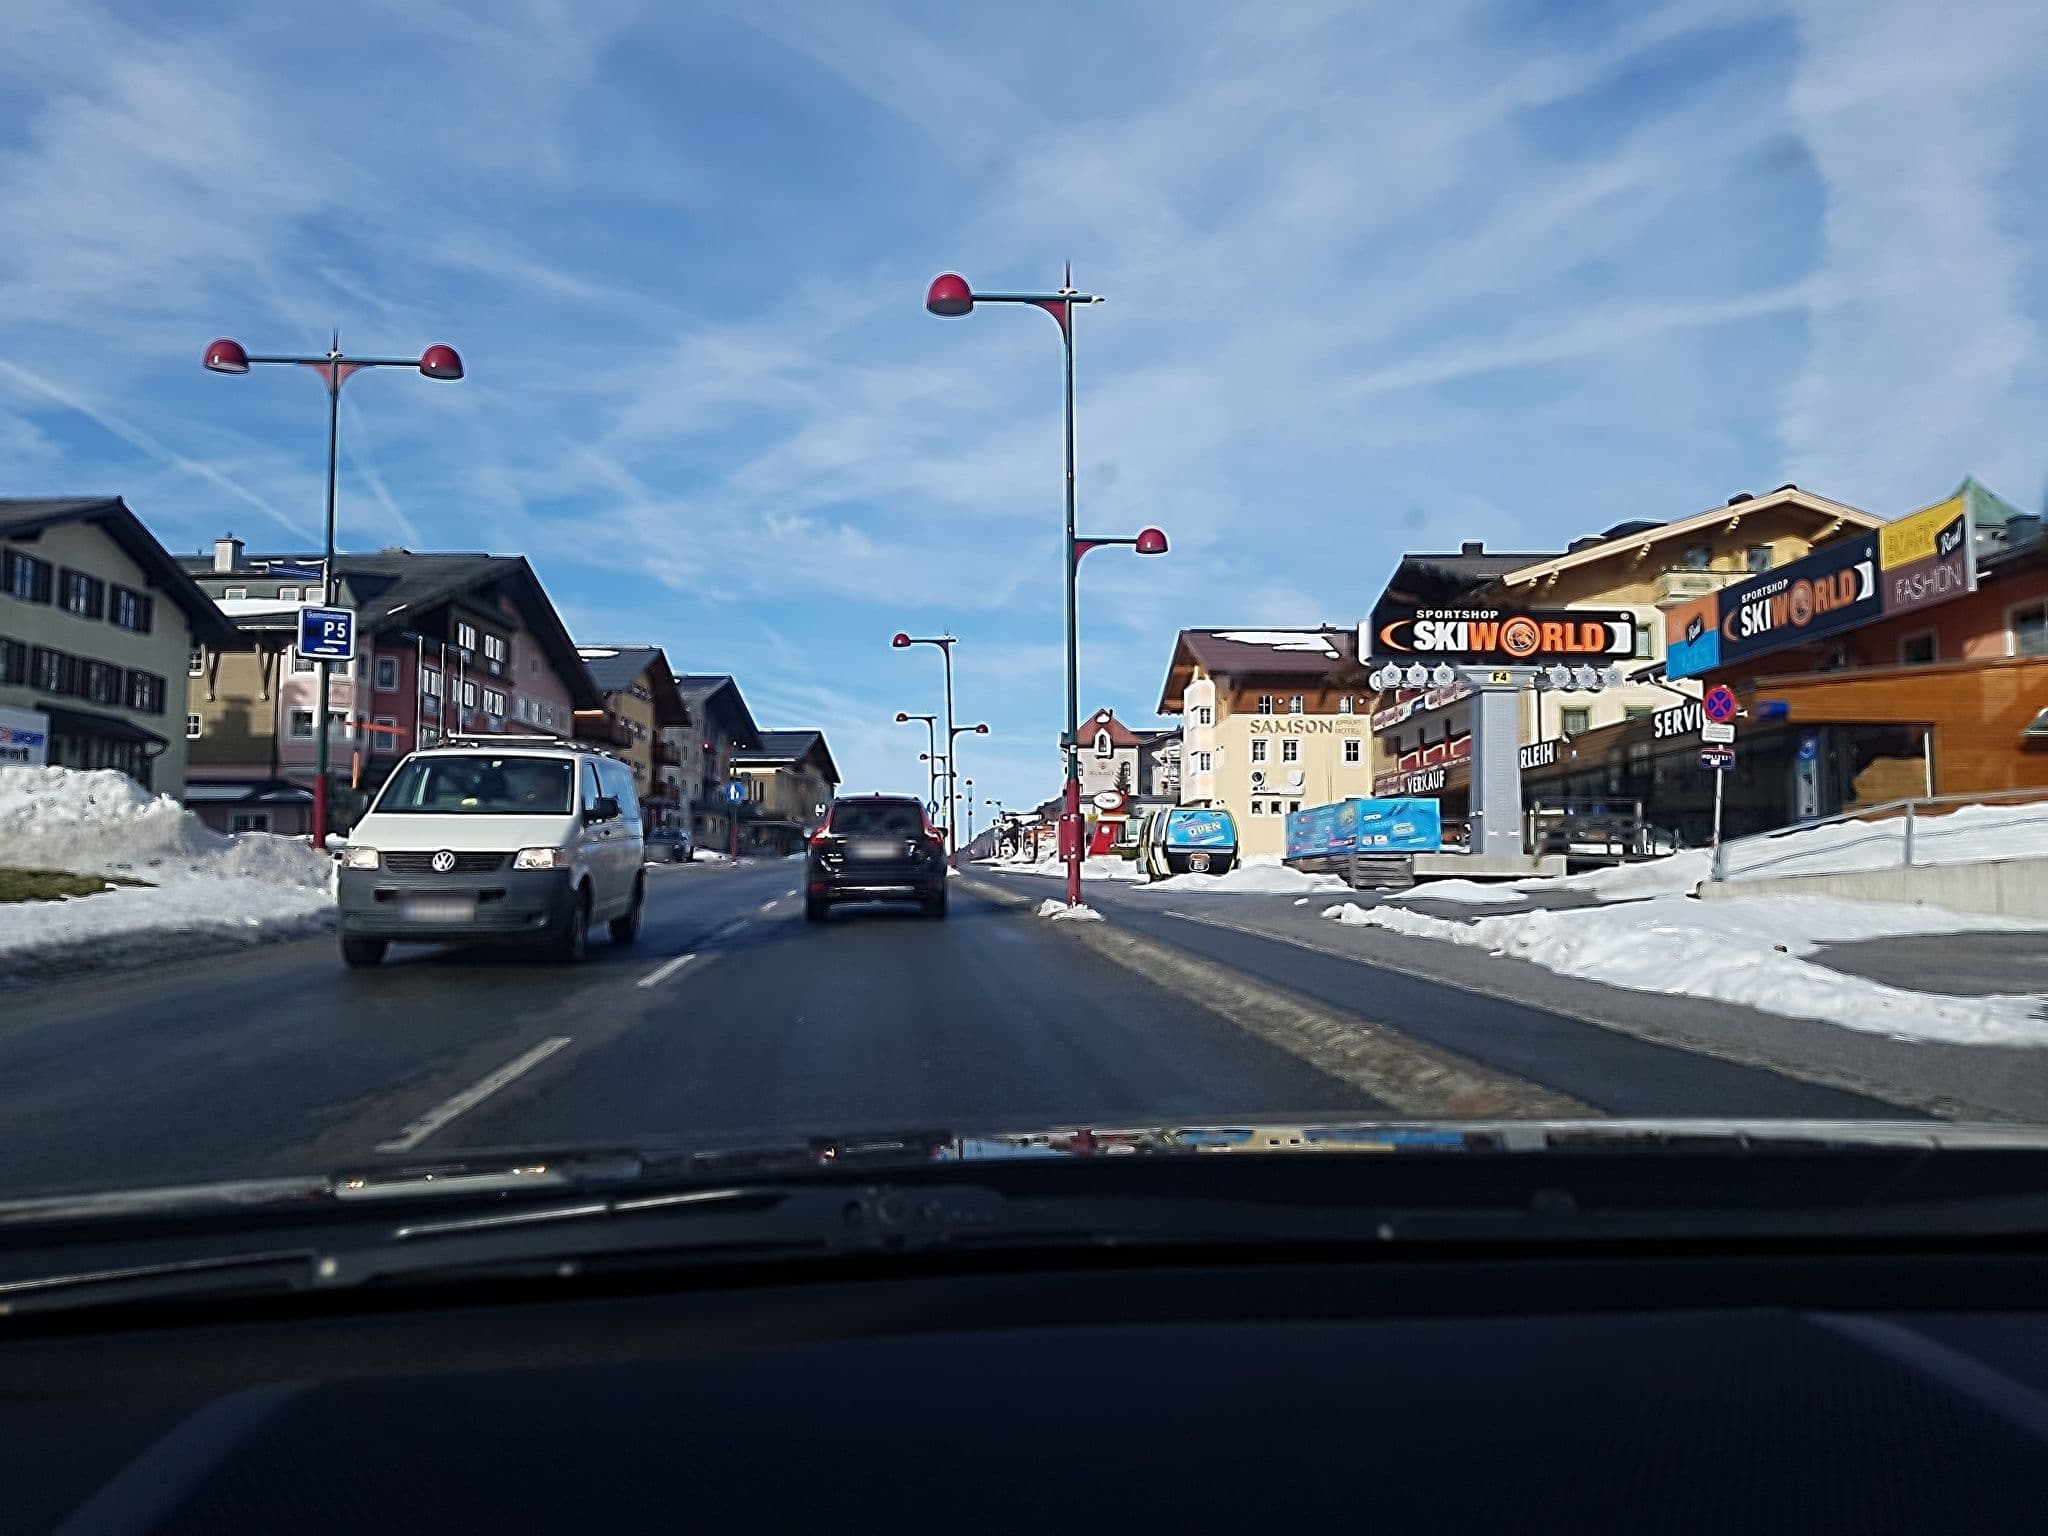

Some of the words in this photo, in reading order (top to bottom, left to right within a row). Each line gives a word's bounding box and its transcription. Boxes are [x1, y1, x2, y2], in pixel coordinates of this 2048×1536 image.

[1741, 578, 1789, 603] SPORTSHOP
[1895, 560, 1962, 605] FASHION
[1416, 609, 1499, 619] SPORTSHOP
[1740, 568, 1857, 637] SKIWORLD
[1413, 616, 1605, 657] SKIWORLD
[1492, 671, 1508, 682] F4
[1250, 719, 1333, 734] SAMSON
[1654, 703, 1705, 738] SERVI
[1407, 770, 1445, 793] VERKAUF
[1188, 821, 1222, 837] OPEN
